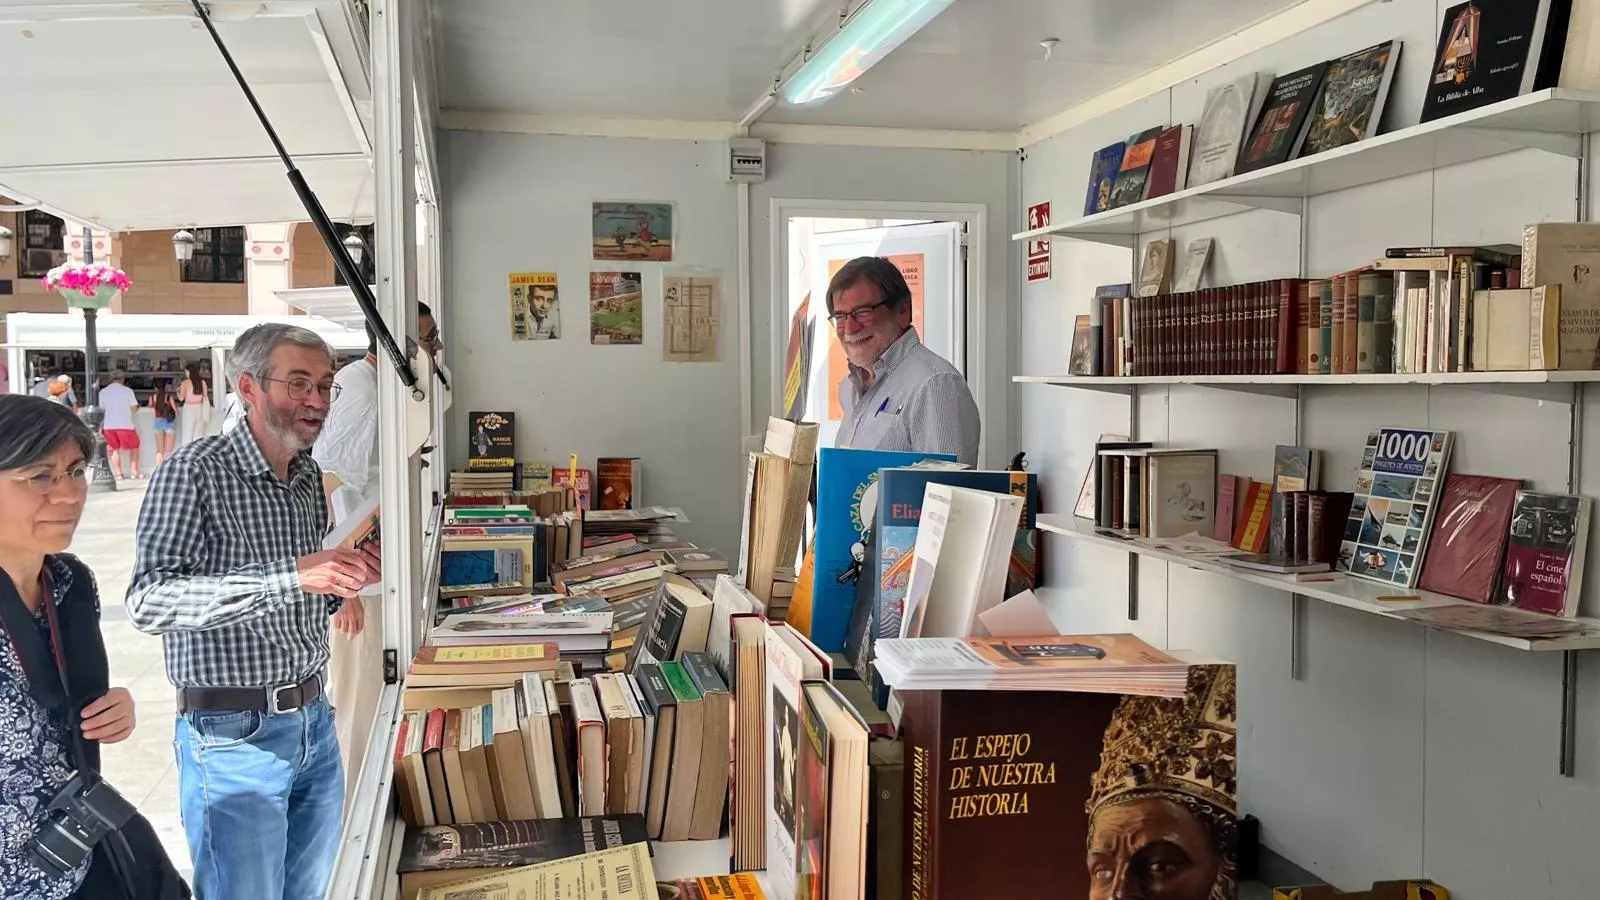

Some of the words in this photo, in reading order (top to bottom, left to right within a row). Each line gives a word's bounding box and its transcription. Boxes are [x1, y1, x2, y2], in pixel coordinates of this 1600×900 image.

[511, 276, 535, 284] JAMES
[538, 275, 556, 284] DEAN
[1377, 432, 1430, 462] 1000
[852, 482, 871, 501] DEL
[849, 502, 862, 532] CAZA
[1530, 573, 1562, 585] español
[1536, 560, 1545, 570] El
[1546, 563, 1564, 574] cine
[949, 737, 968, 761] EL
[973, 733, 1031, 763] ESPEJO
[913, 745, 924, 810] HISTORIA
[949, 766, 973, 791] DE
[976, 761, 1057, 788] NUESTRA
[948, 792, 1029, 820] HISTORIA
[912, 810, 923, 868] NUESTRA
[911, 868, 922, 890] DE
